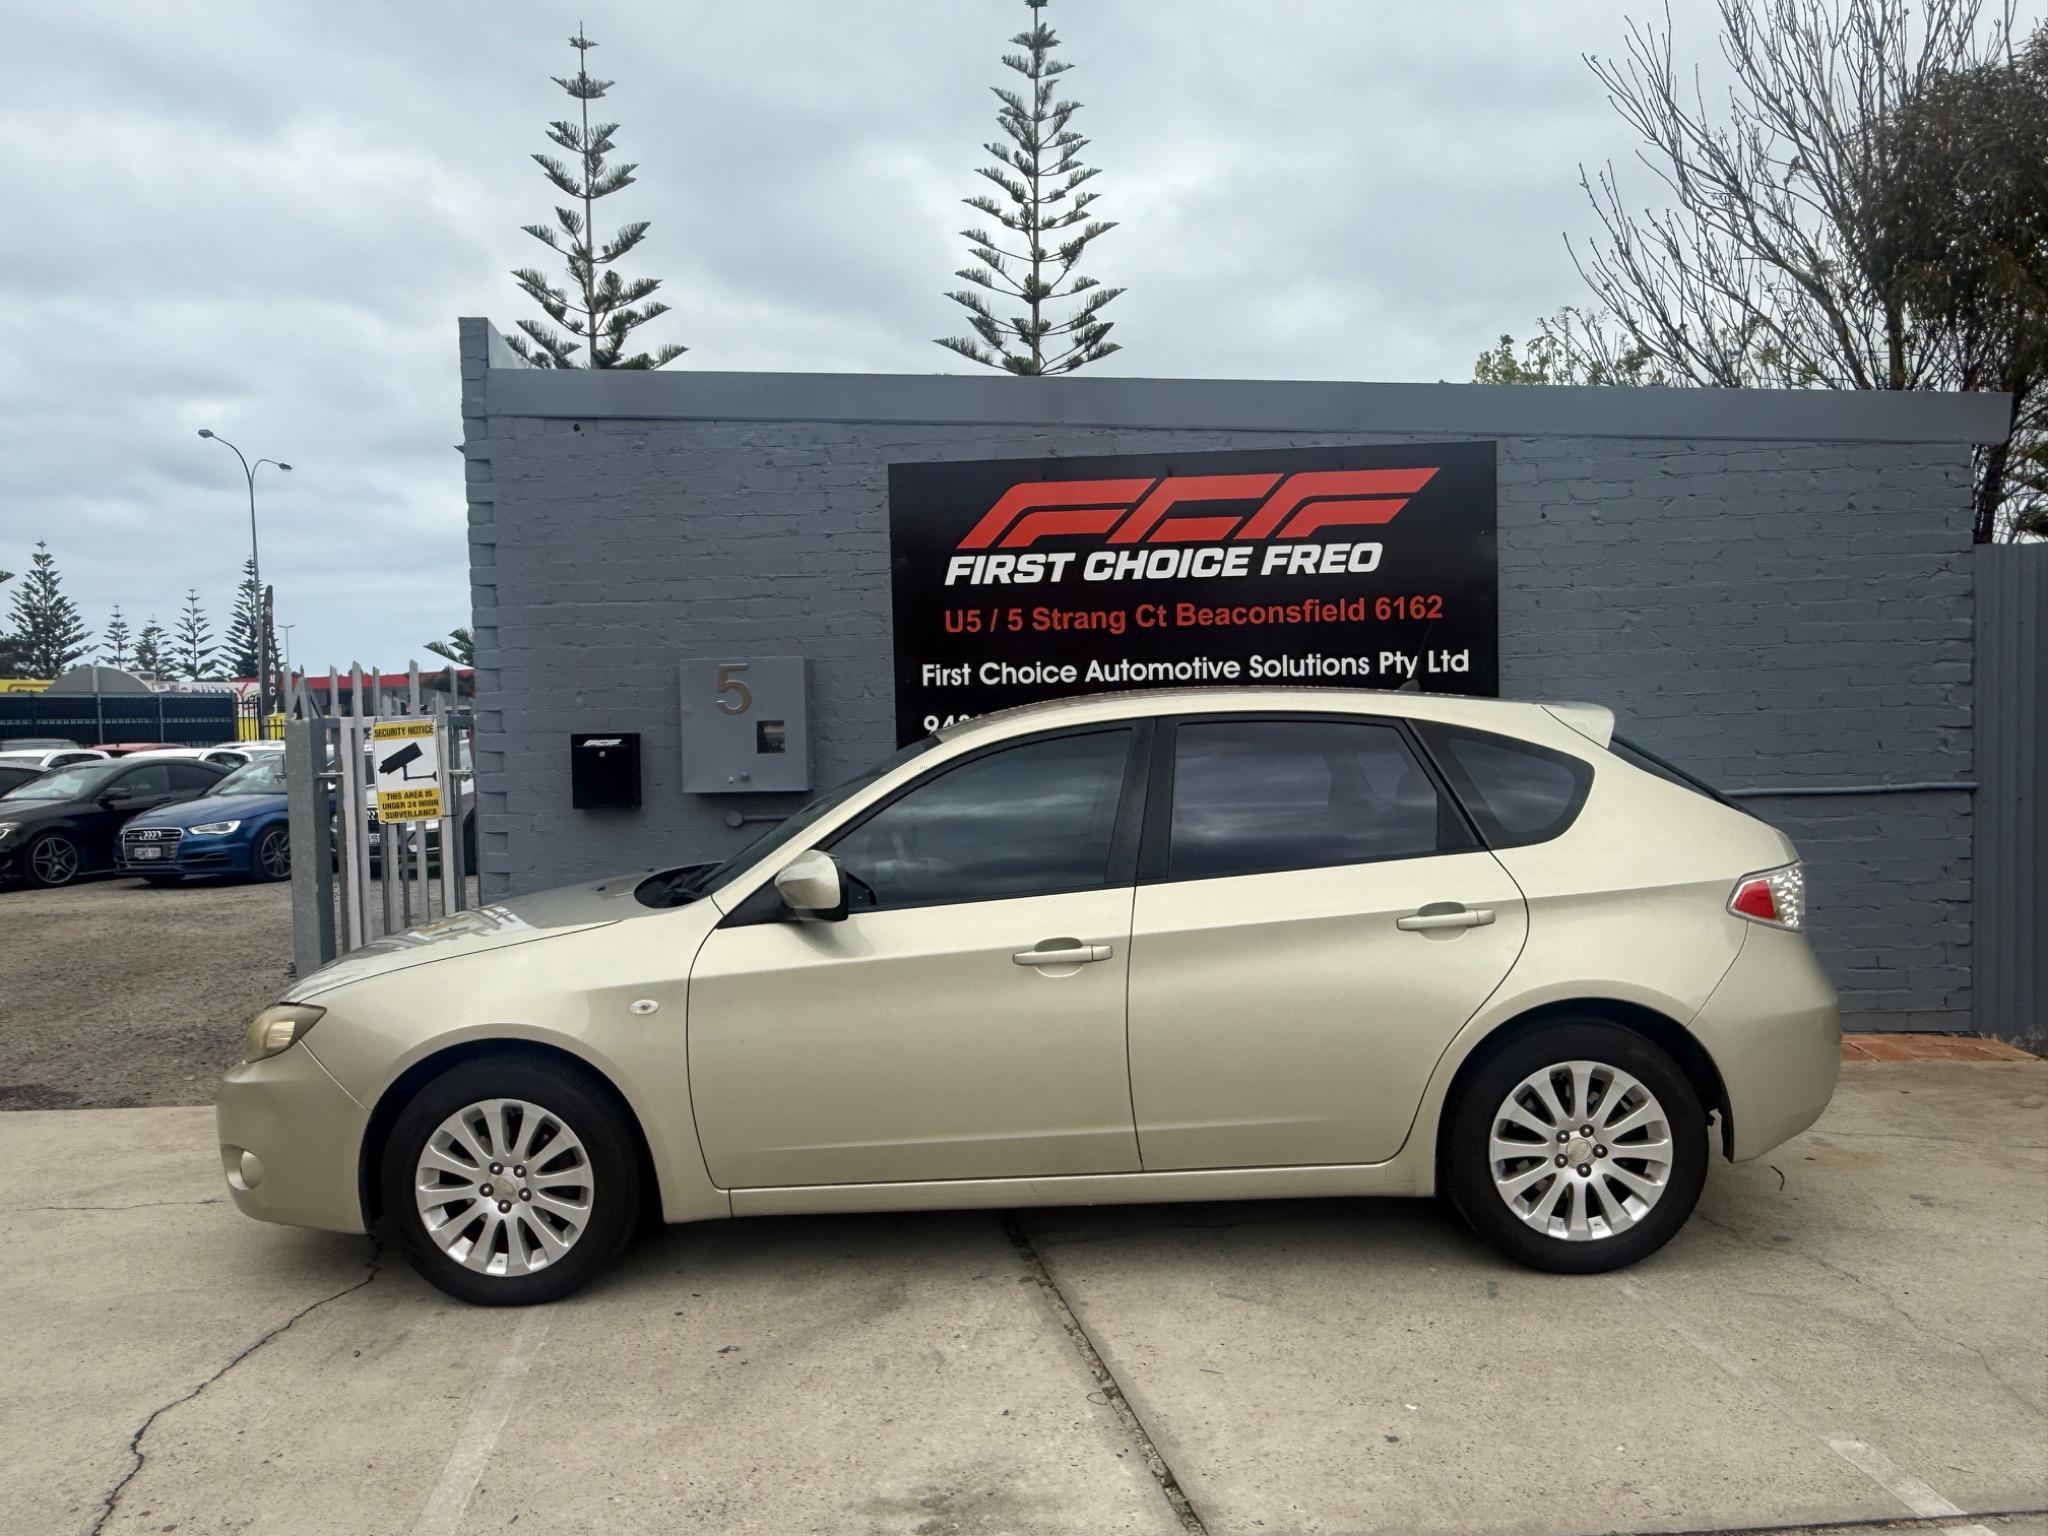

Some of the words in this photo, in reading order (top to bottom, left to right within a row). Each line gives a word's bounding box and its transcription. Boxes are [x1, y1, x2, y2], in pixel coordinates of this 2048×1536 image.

[944, 552, 1077, 586] FIRST
[1083, 546, 1254, 582] CHOICE
[1260, 542, 1384, 576] FREO
[945, 609, 982, 634] U5
[989, 608, 999, 633] /
[1007, 607, 1024, 631] 5
[1032, 606, 1127, 635] Strang
[1135, 603, 1168, 628] Ct
[1176, 597, 1366, 627] Beaconsfield
[1375, 595, 1443, 621] 6162
[921, 663, 972, 687] First
[979, 661, 1078, 686] Choice
[1085, 655, 1241, 683] Automotive
[1249, 653, 1371, 679] Solutions
[1379, 650, 1419, 679] Pty
[1427, 649, 1470, 674] Ltd
[716, 663, 752, 716] 5
[375, 726, 406, 738] SECURITY
[408, 724, 434, 735] NOTICE
[382, 802, 406, 811] UNDER
[418, 799, 439, 808] HOUR
[387, 792, 402, 801] THIS
[404, 791, 422, 799] AREA
[425, 790, 433, 798] IS
[385, 808, 438, 820] SURVEILLANCE
